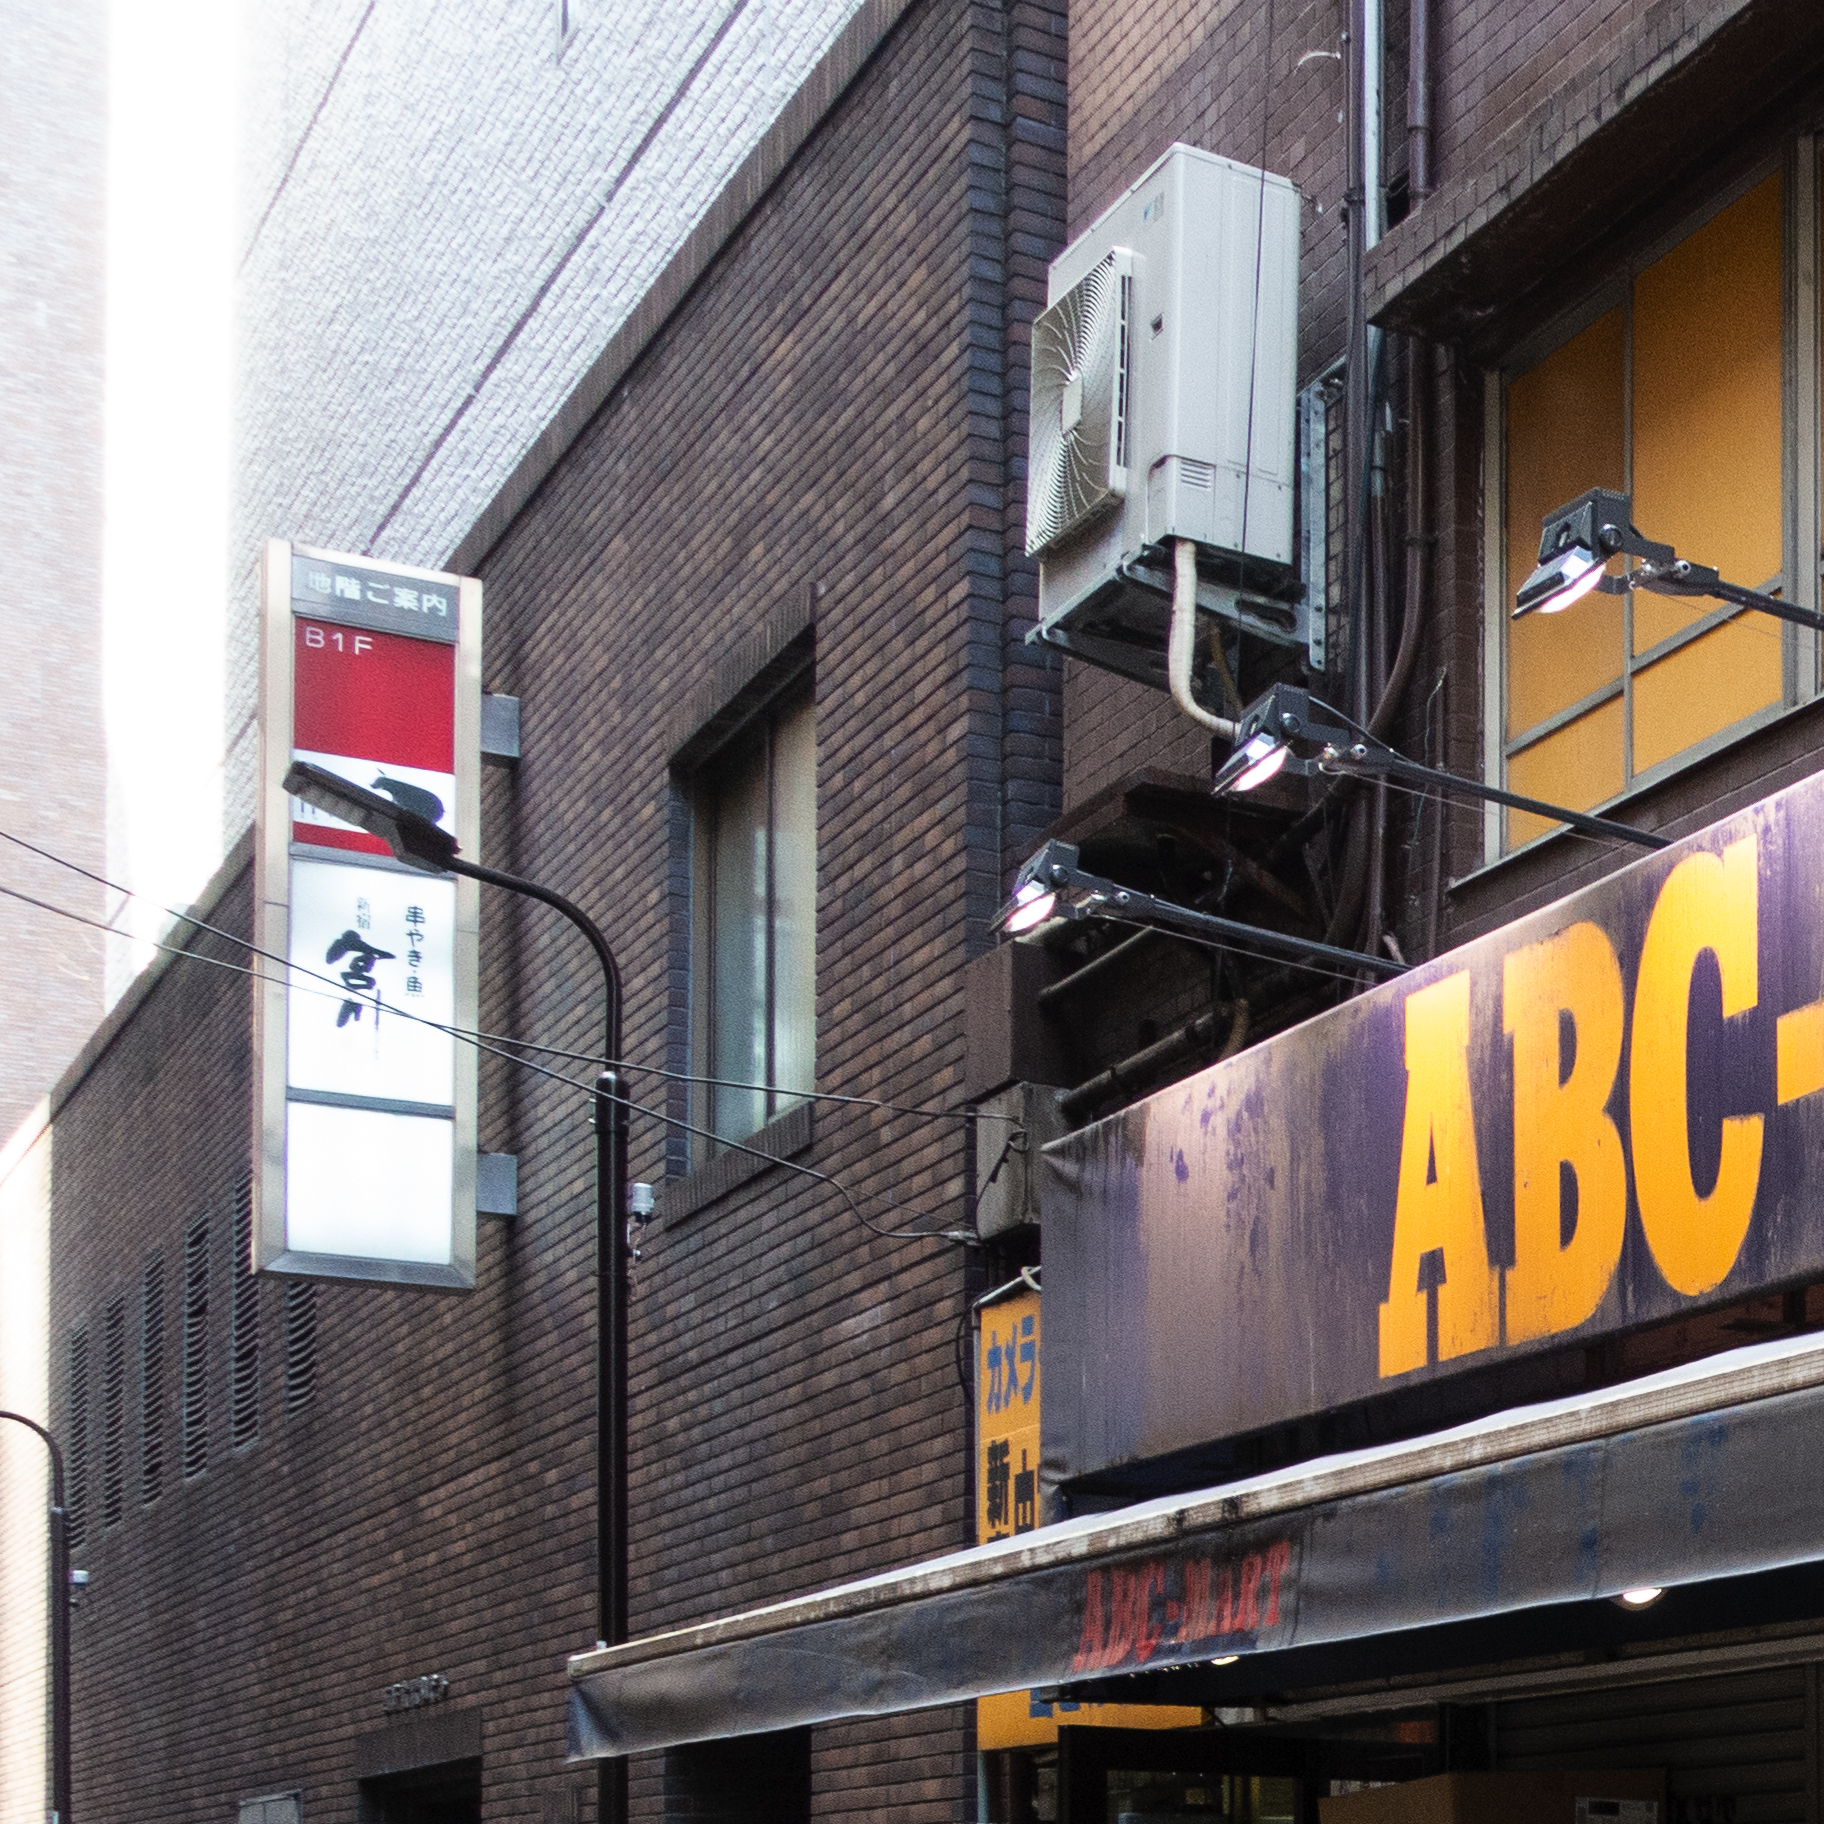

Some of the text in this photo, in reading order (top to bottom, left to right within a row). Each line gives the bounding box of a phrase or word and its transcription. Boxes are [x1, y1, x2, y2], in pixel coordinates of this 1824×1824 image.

[308, 571, 447, 617] 地階ご案内
[305, 626, 373, 655] B1F
[986, 1314, 1036, 1415] カメラ
